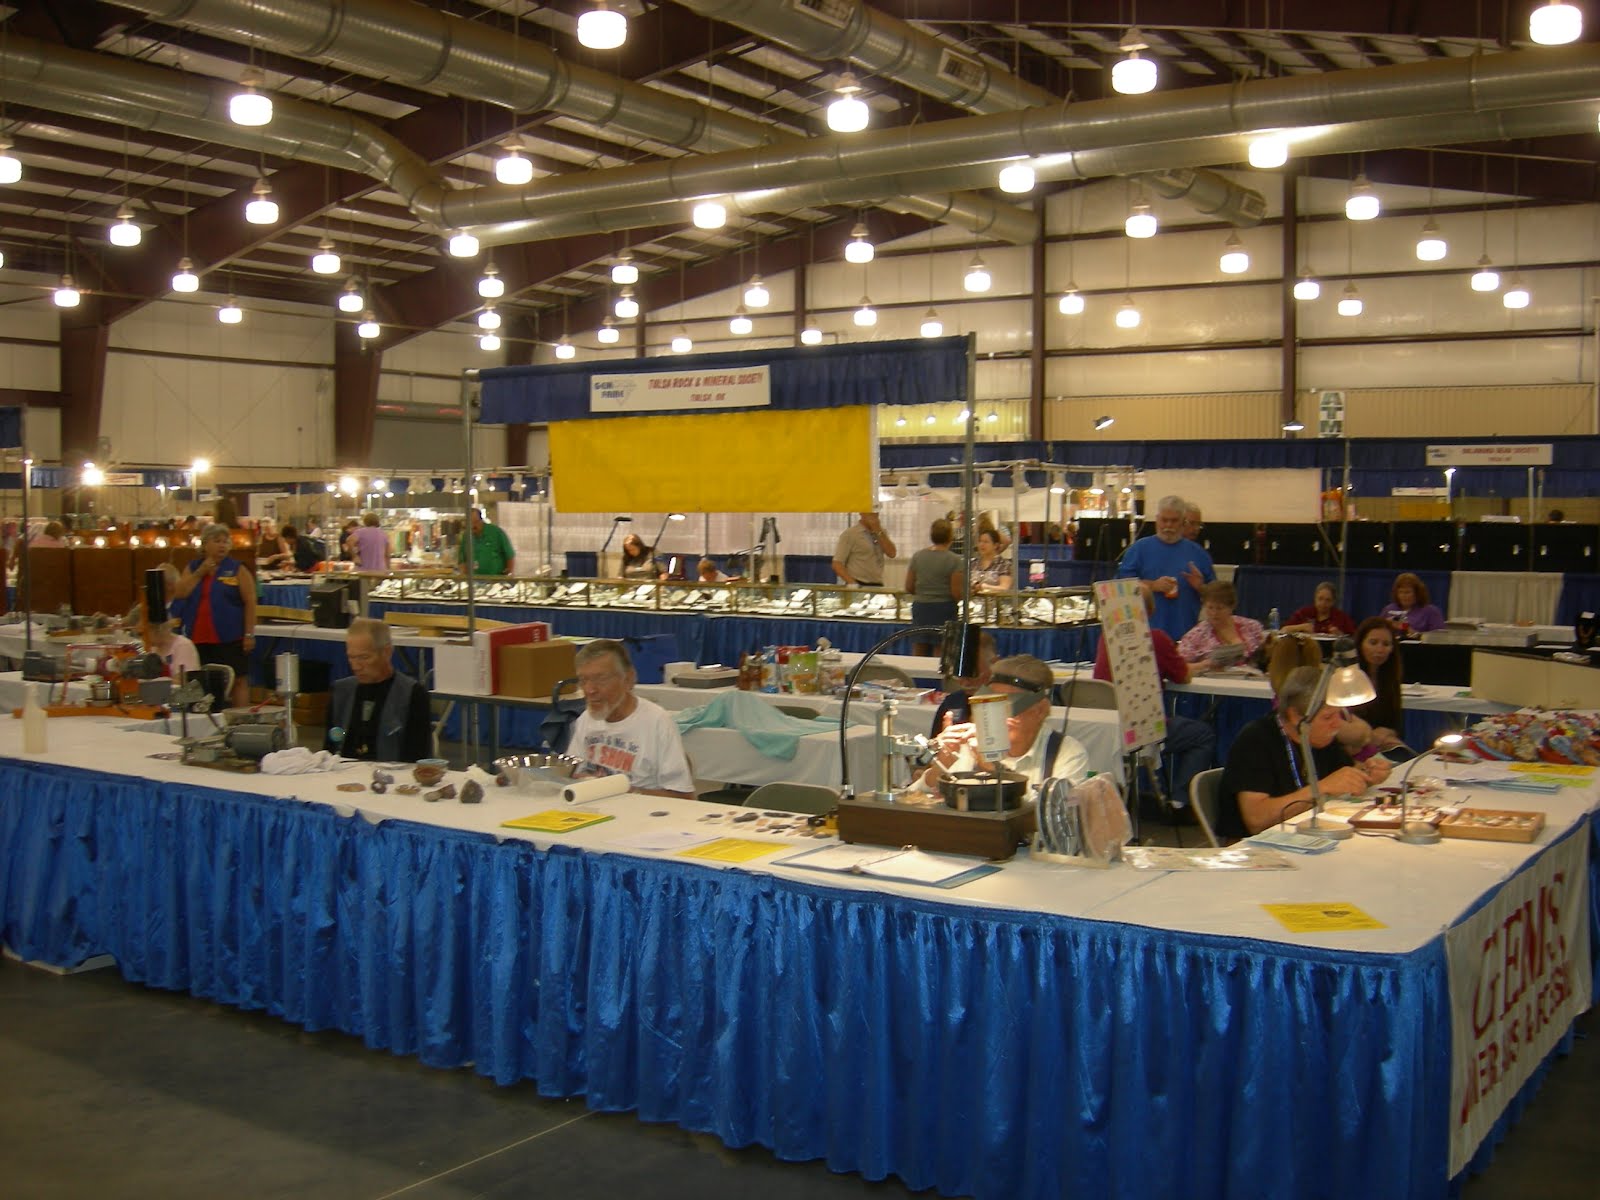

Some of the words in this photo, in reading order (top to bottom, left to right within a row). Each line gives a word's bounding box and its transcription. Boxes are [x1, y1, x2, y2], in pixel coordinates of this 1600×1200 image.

[672, 377, 693, 388] ROCK
[694, 376, 701, 387] &
[702, 375, 735, 387] MINERAL
[737, 372, 764, 385] SOCIETY
[1320, 392, 1343, 433] ATM
